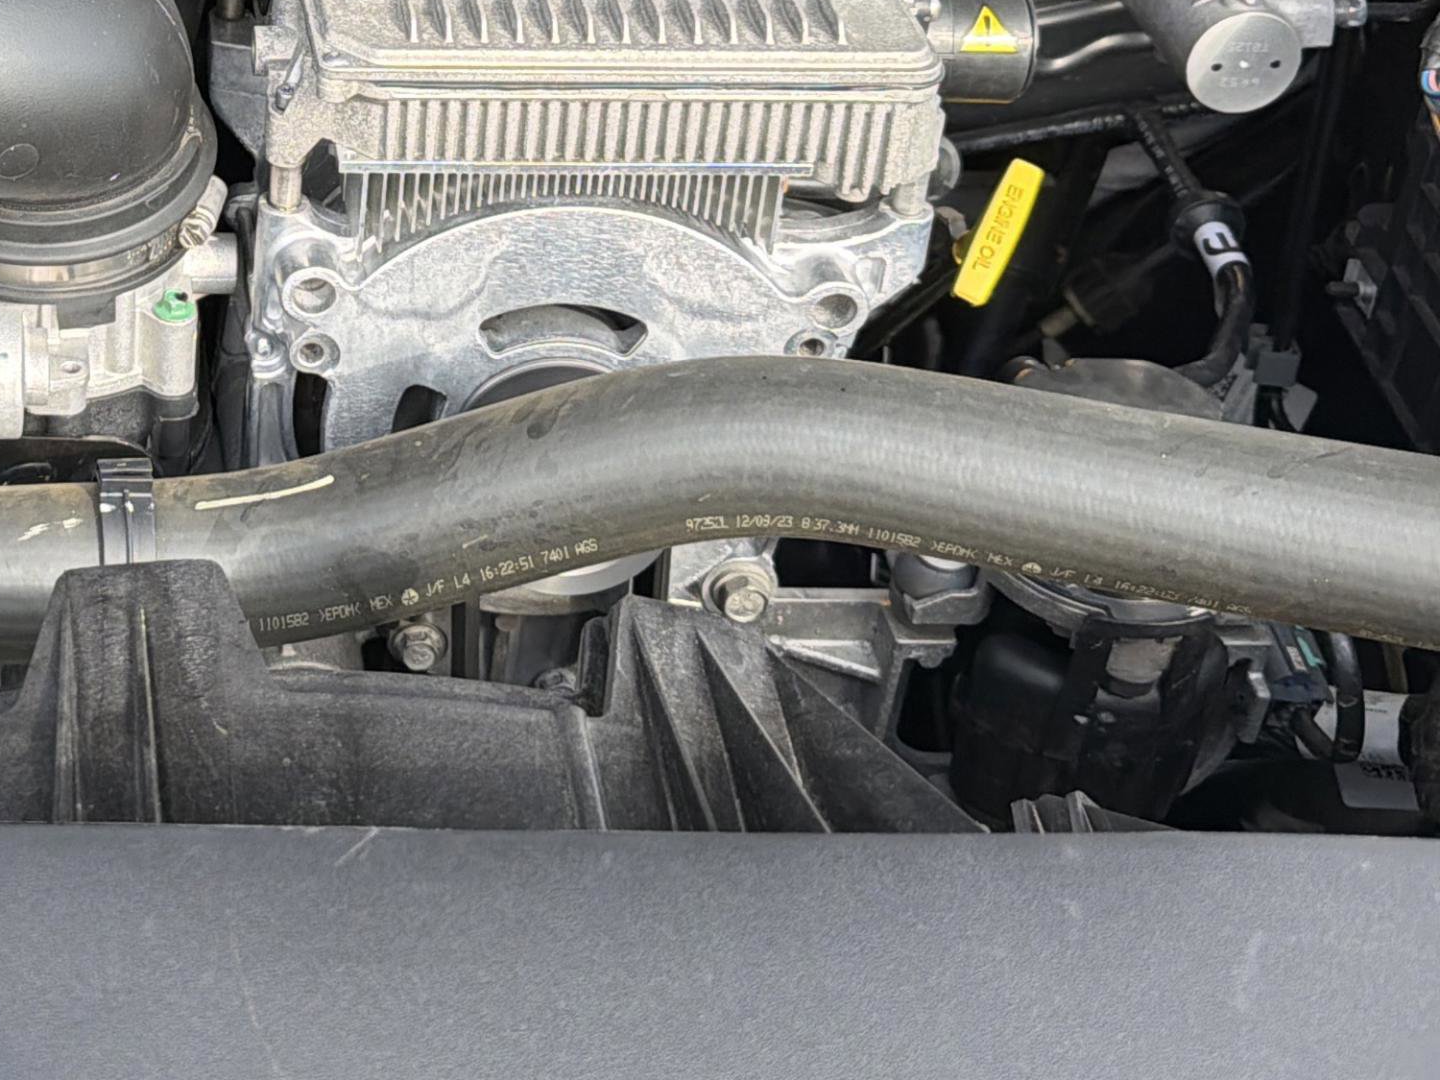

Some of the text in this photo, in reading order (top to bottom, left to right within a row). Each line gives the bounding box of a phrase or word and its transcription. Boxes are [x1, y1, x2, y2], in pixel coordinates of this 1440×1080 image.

[972, 184, 1025, 269] ENGINE OIL
[259, 613, 310, 632] 1101582
[370, 595, 393, 612] MEX
[480, 559, 535, 582] 16:22:51
[541, 547, 571, 567] 7401
[575, 539, 599, 556] AGS
